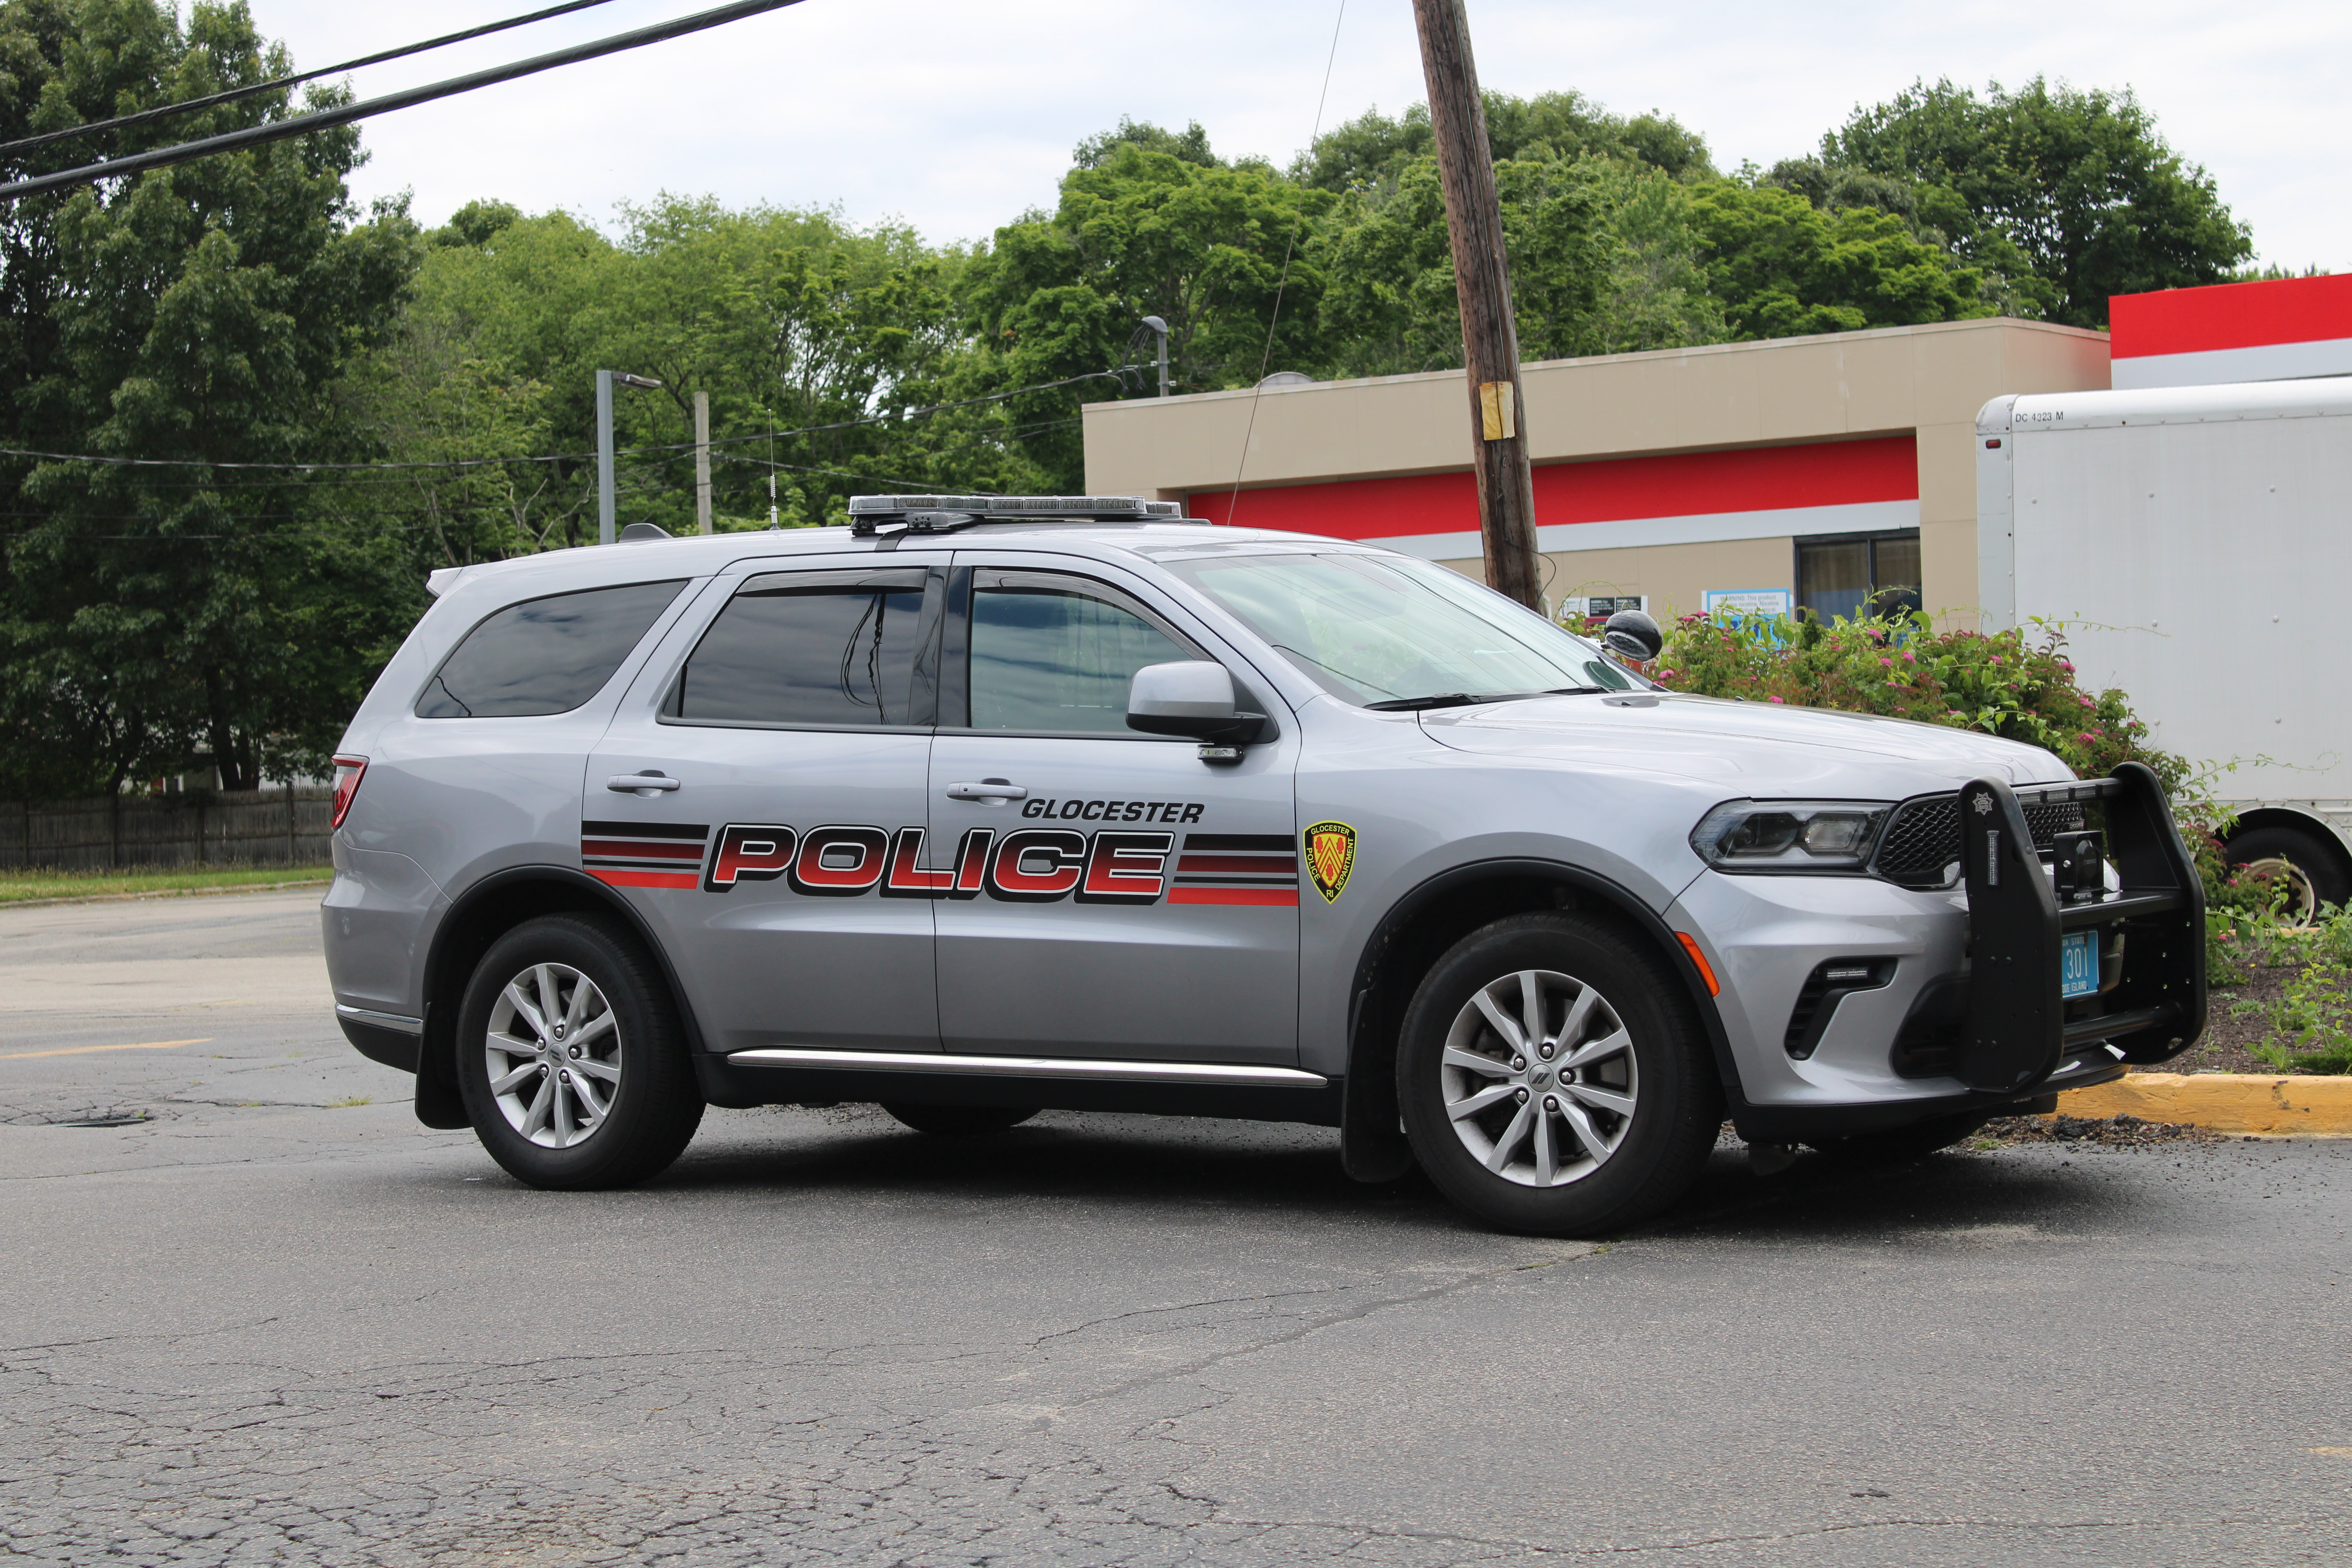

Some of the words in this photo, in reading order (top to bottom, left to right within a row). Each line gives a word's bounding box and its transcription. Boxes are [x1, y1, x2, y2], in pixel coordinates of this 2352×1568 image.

[2016, 414, 2028, 422] DC
[2032, 412, 2052, 422] 4323
[2056, 411, 2063, 420] M
[1021, 799, 1205, 824] GLOCESTER
[1311, 825, 1350, 836] GLOCESTER
[703, 822, 1176, 906] POLICE
[1307, 847, 1321, 881] POLICE
[1335, 837, 1354, 891] DEPARTMENT
[1326, 889, 1334, 898] RI
[2067, 947, 2088, 980] 301
[2071, 980, 2087, 991] ISLAND
